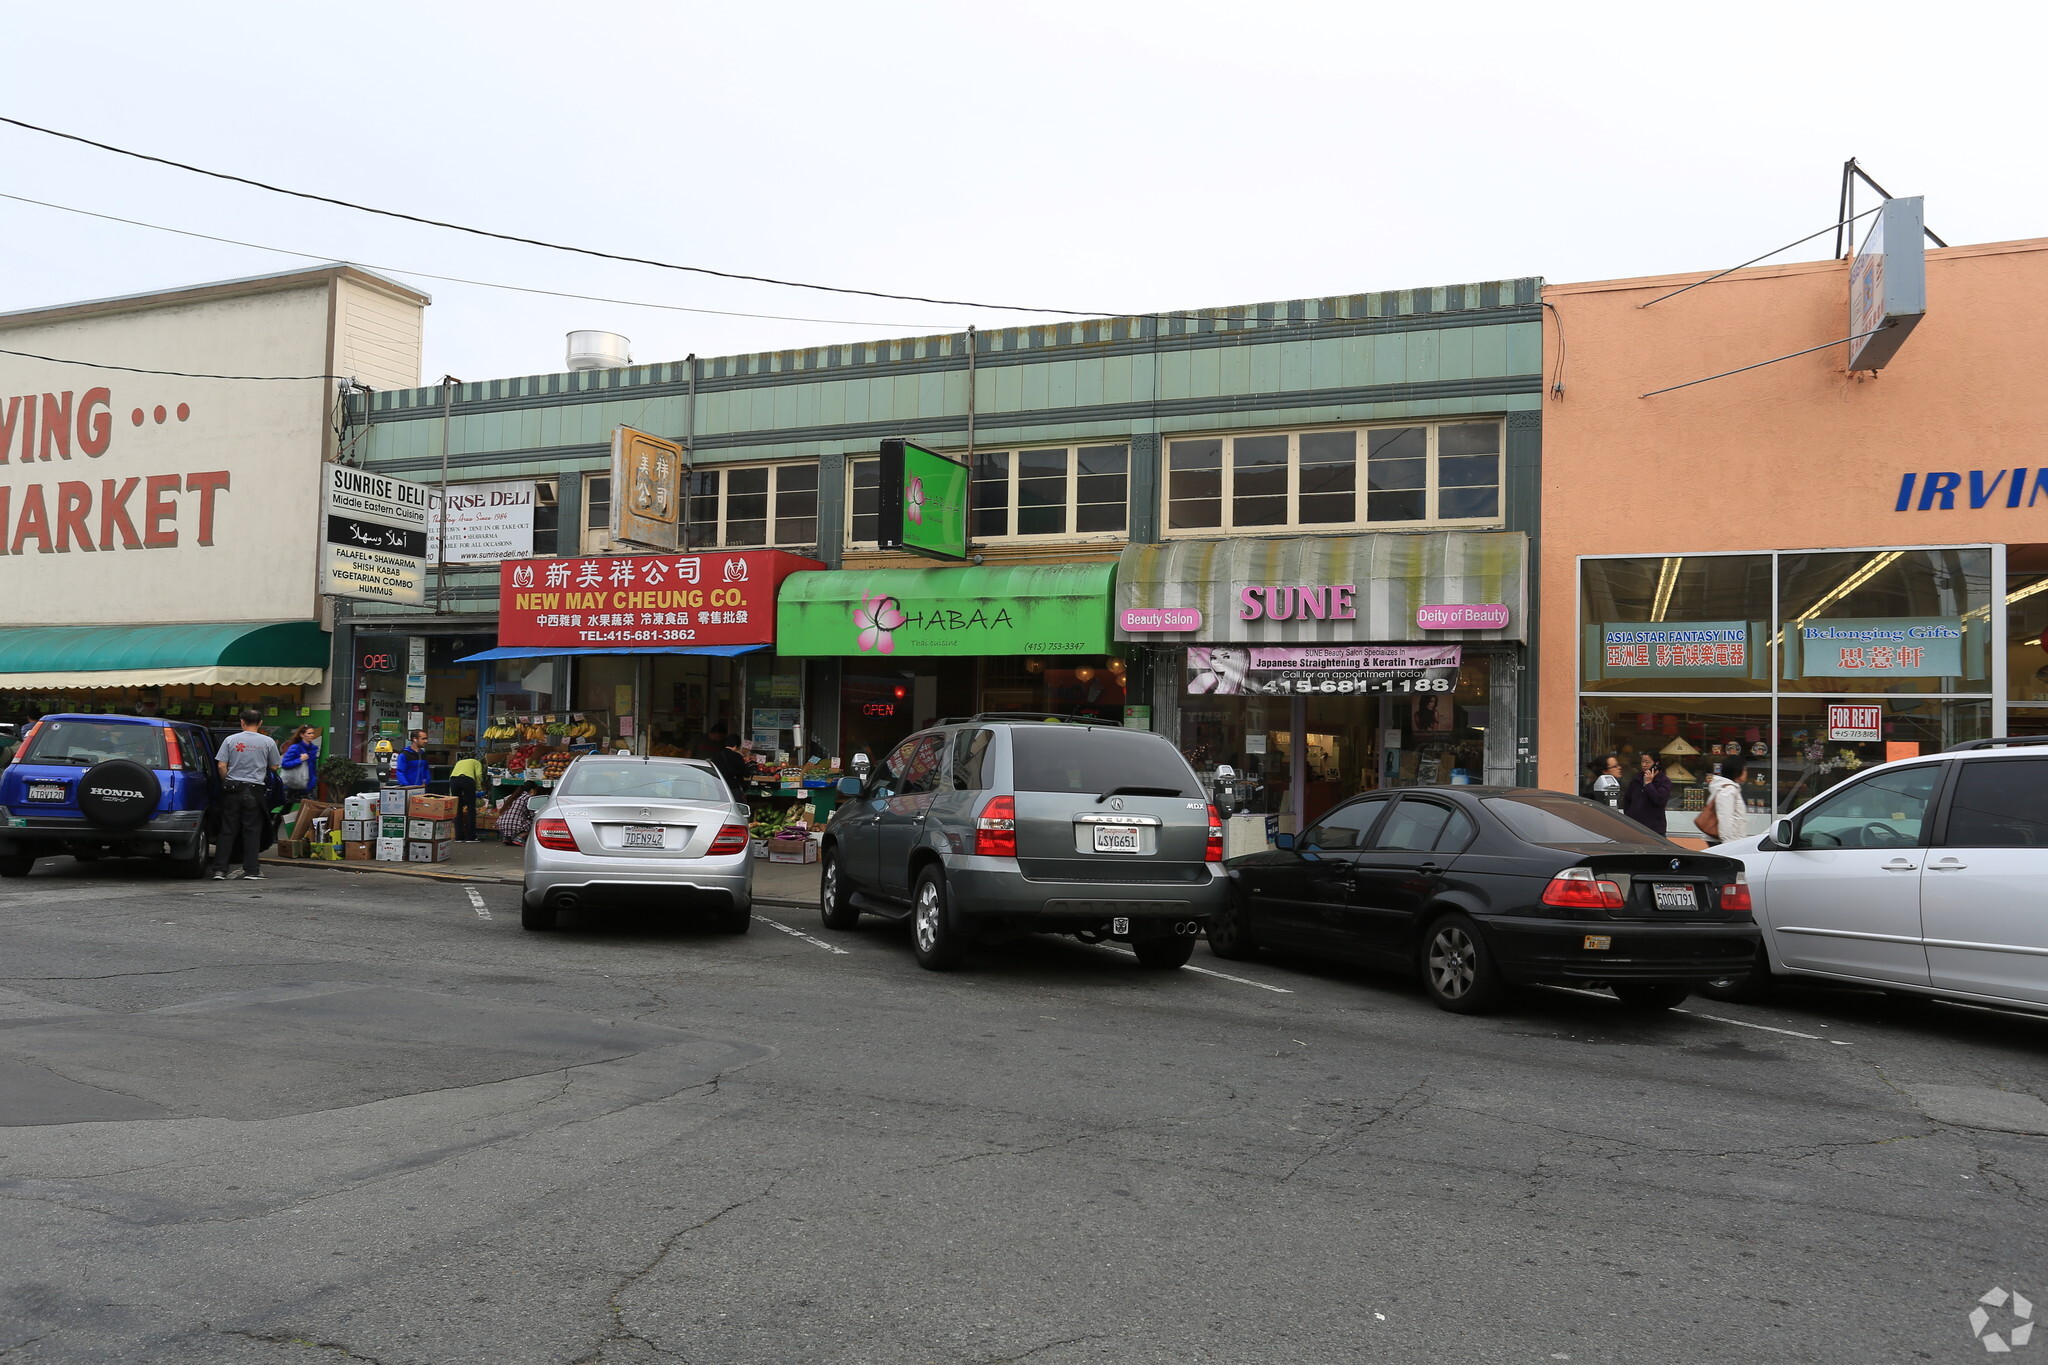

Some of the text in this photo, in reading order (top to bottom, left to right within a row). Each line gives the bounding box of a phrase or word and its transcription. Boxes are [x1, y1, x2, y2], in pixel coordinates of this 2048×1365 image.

[334, 470, 424, 506] SUNRISE DELI
[332, 494, 424, 520] Middle Eastern Cuisine
[428, 491, 530, 511] URISE DELI
[458, 513, 472, 522] Area
[476, 512, 492, 521] Since
[336, 548, 416, 568] FALAFEL SHAWARMA
[460, 550, 528, 559] www.sunrisedeli.net
[352, 562, 400, 576] SHISH KABAB
[545, 556, 701, 589] 新美祥公司
[332, 570, 413, 588] VEGETARIAN COMBO
[359, 584, 393, 596] HUMMUS
[516, 587, 747, 610] NEW MAY CHEUNG CO.
[1239, 584, 1357, 621] SUNE
[536, 610, 748, 627] 中西雜貨 水果蔬菜 冷凍食品 零售批發
[874, 596, 1013, 632] CHABAA
[1126, 612, 1193, 627] Beauty Salon
[1419, 608, 1506, 624] Deity of Beauty
[579, 629, 695, 641] TEL:415-681-3862
[1606, 630, 1745, 643] ASIA STAR FANTASY INC
[1804, 625, 1960, 642] Belonging Gifts
[910, 639, 958, 648] Thai cuisine
[1024, 642, 1085, 652] (415) 753-3347
[1324, 649, 1344, 658] Beauty
[1363, 649, 1398, 658] Specializes
[1607, 643, 1744, 667] 亞洲星 影音娛樂電器
[364, 654, 397, 669] OPEN
[1256, 656, 1456, 669] Japanese Straightening & Keratin Treatment
[1282, 670, 1304, 678] Call
[1306, 670, 1317, 678] for
[1332, 670, 1395, 679] appointment
[1262, 679, 1449, 693] 415-681-1188
[372, 699, 394, 707] Follow
[863, 704, 894, 716] OPEN
[380, 708, 400, 717] Truck
[1831, 708, 1877, 728] FOR RENT
[30, 789, 64, 800] 4TRV120
[90, 787, 144, 798] HONDA
[625, 832, 662, 844] 7DFN942
[1098, 836, 1136, 848] 4SYG651
